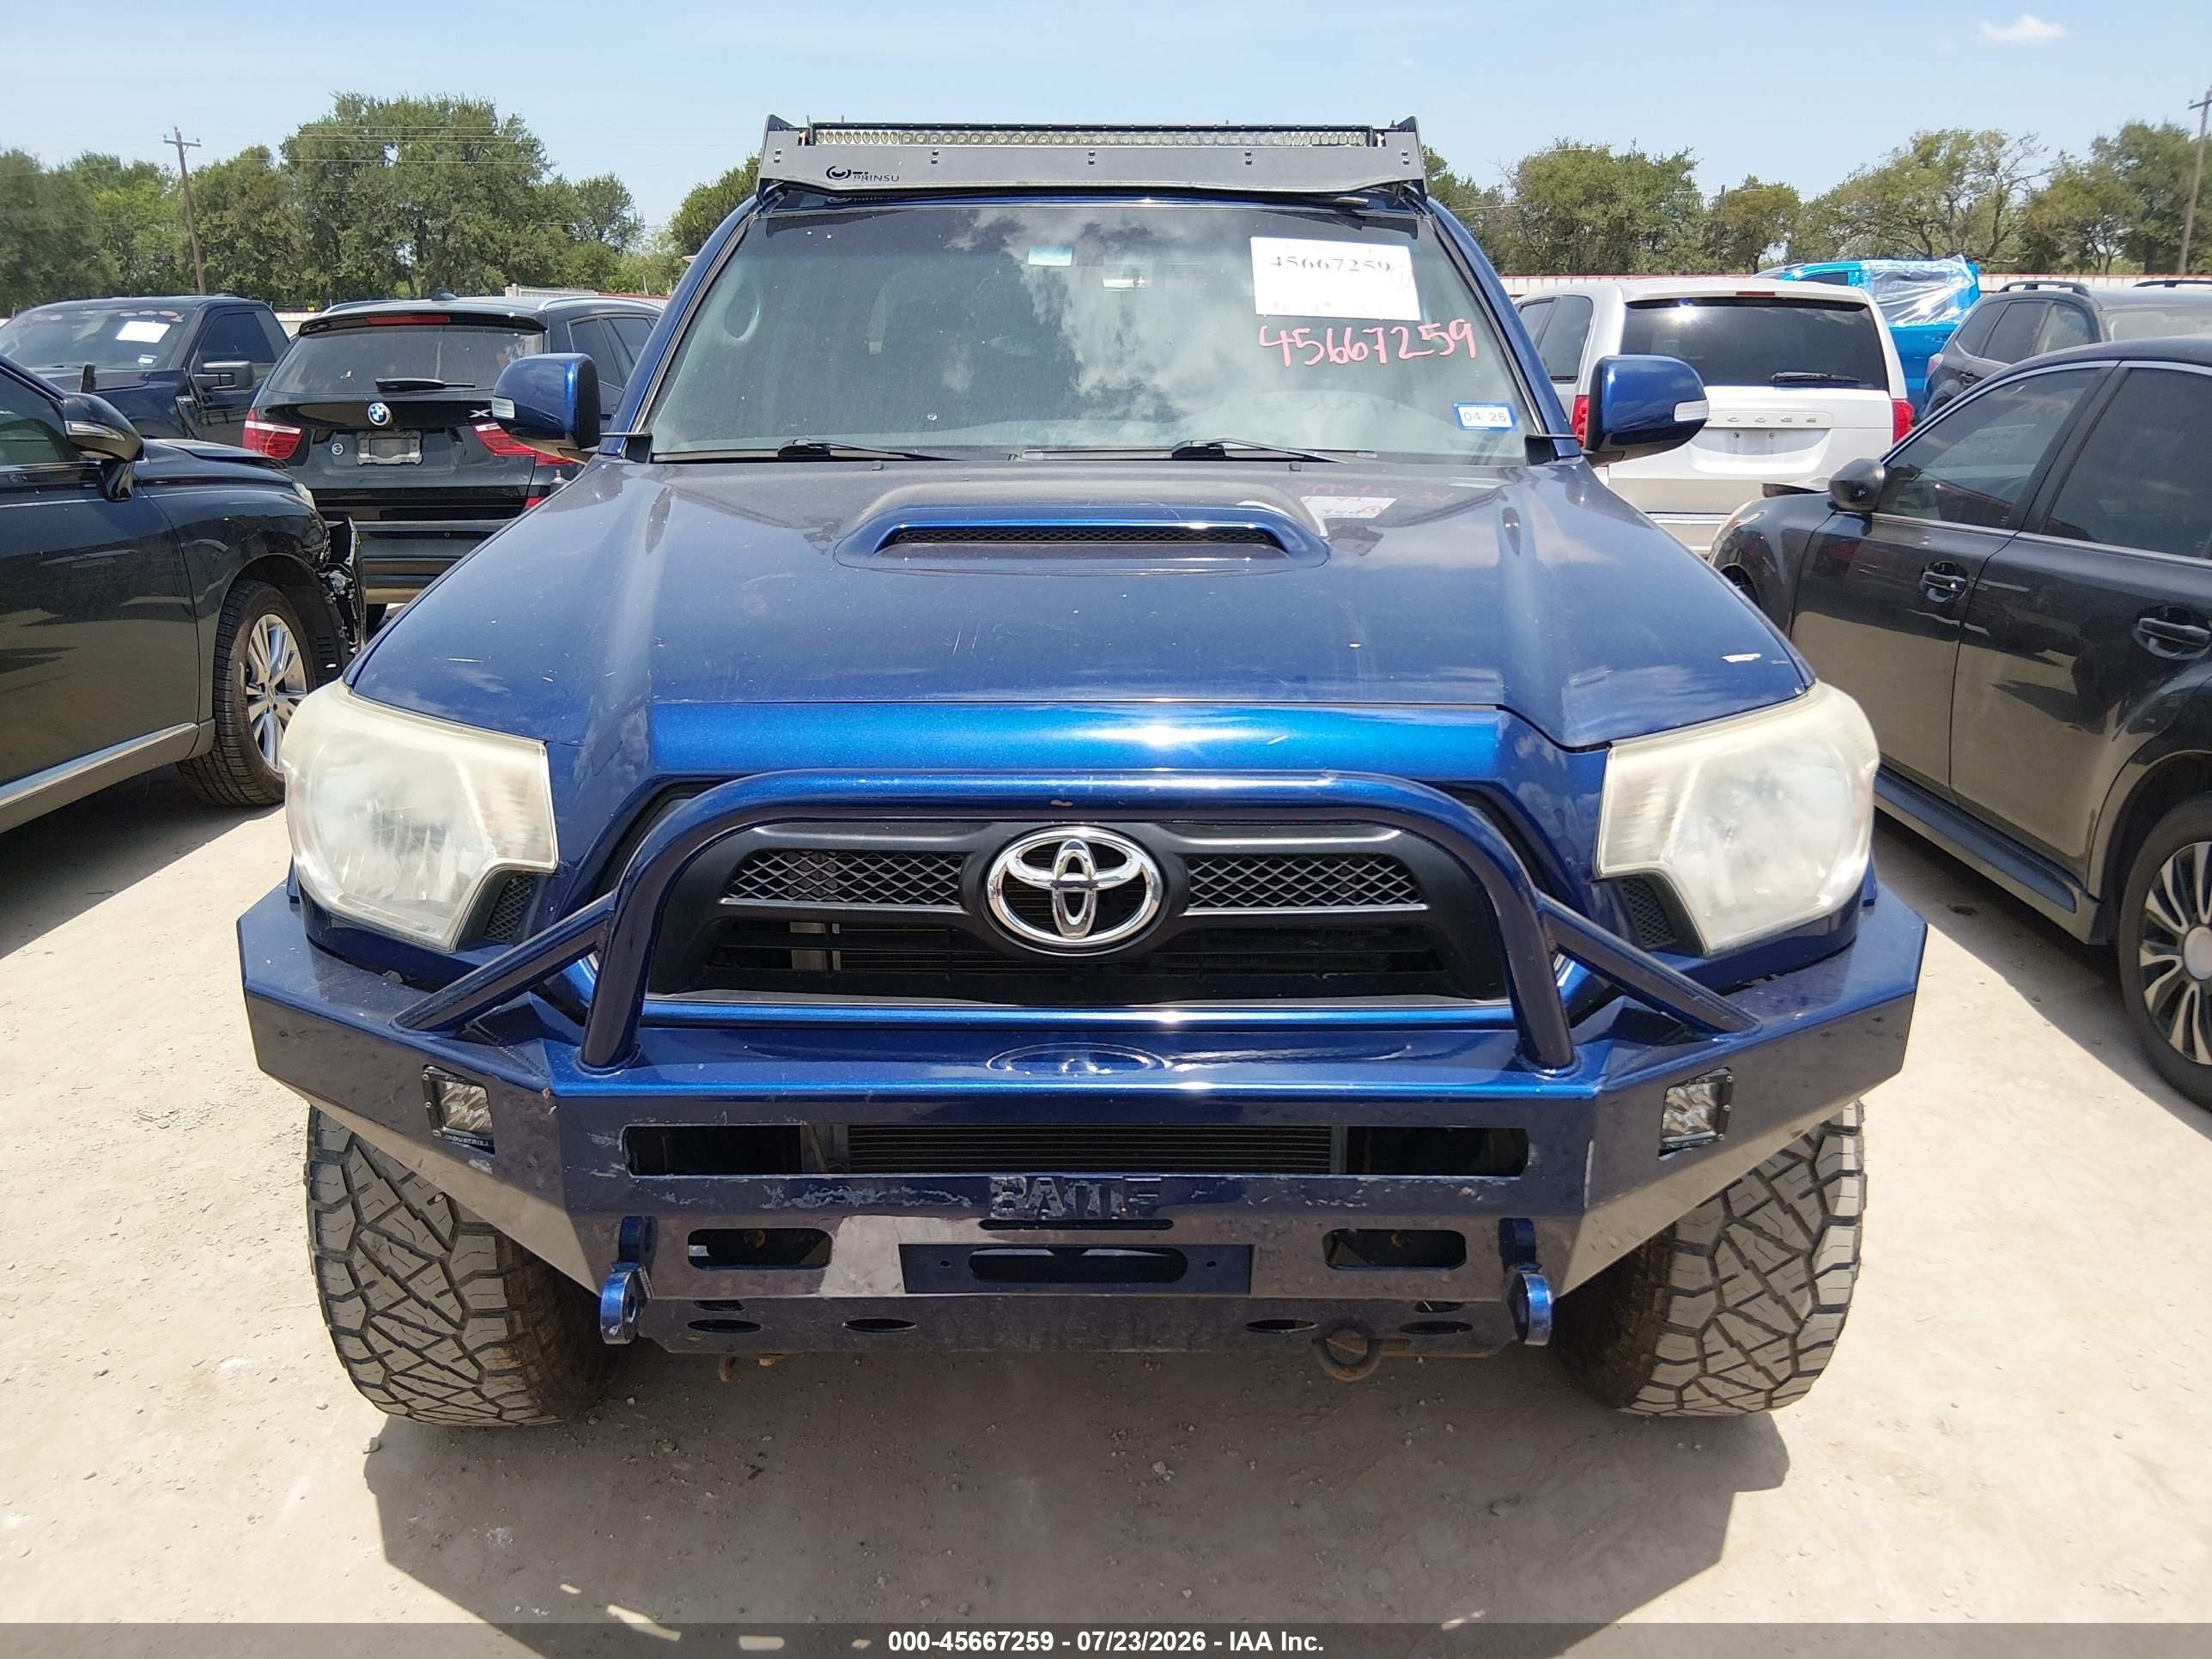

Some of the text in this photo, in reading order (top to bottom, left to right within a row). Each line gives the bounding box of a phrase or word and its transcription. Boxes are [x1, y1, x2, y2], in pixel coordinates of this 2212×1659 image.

[853, 173, 900, 182] PRINSU
[1259, 319, 1476, 368] 45667259
[1463, 411, 1481, 422] 04
